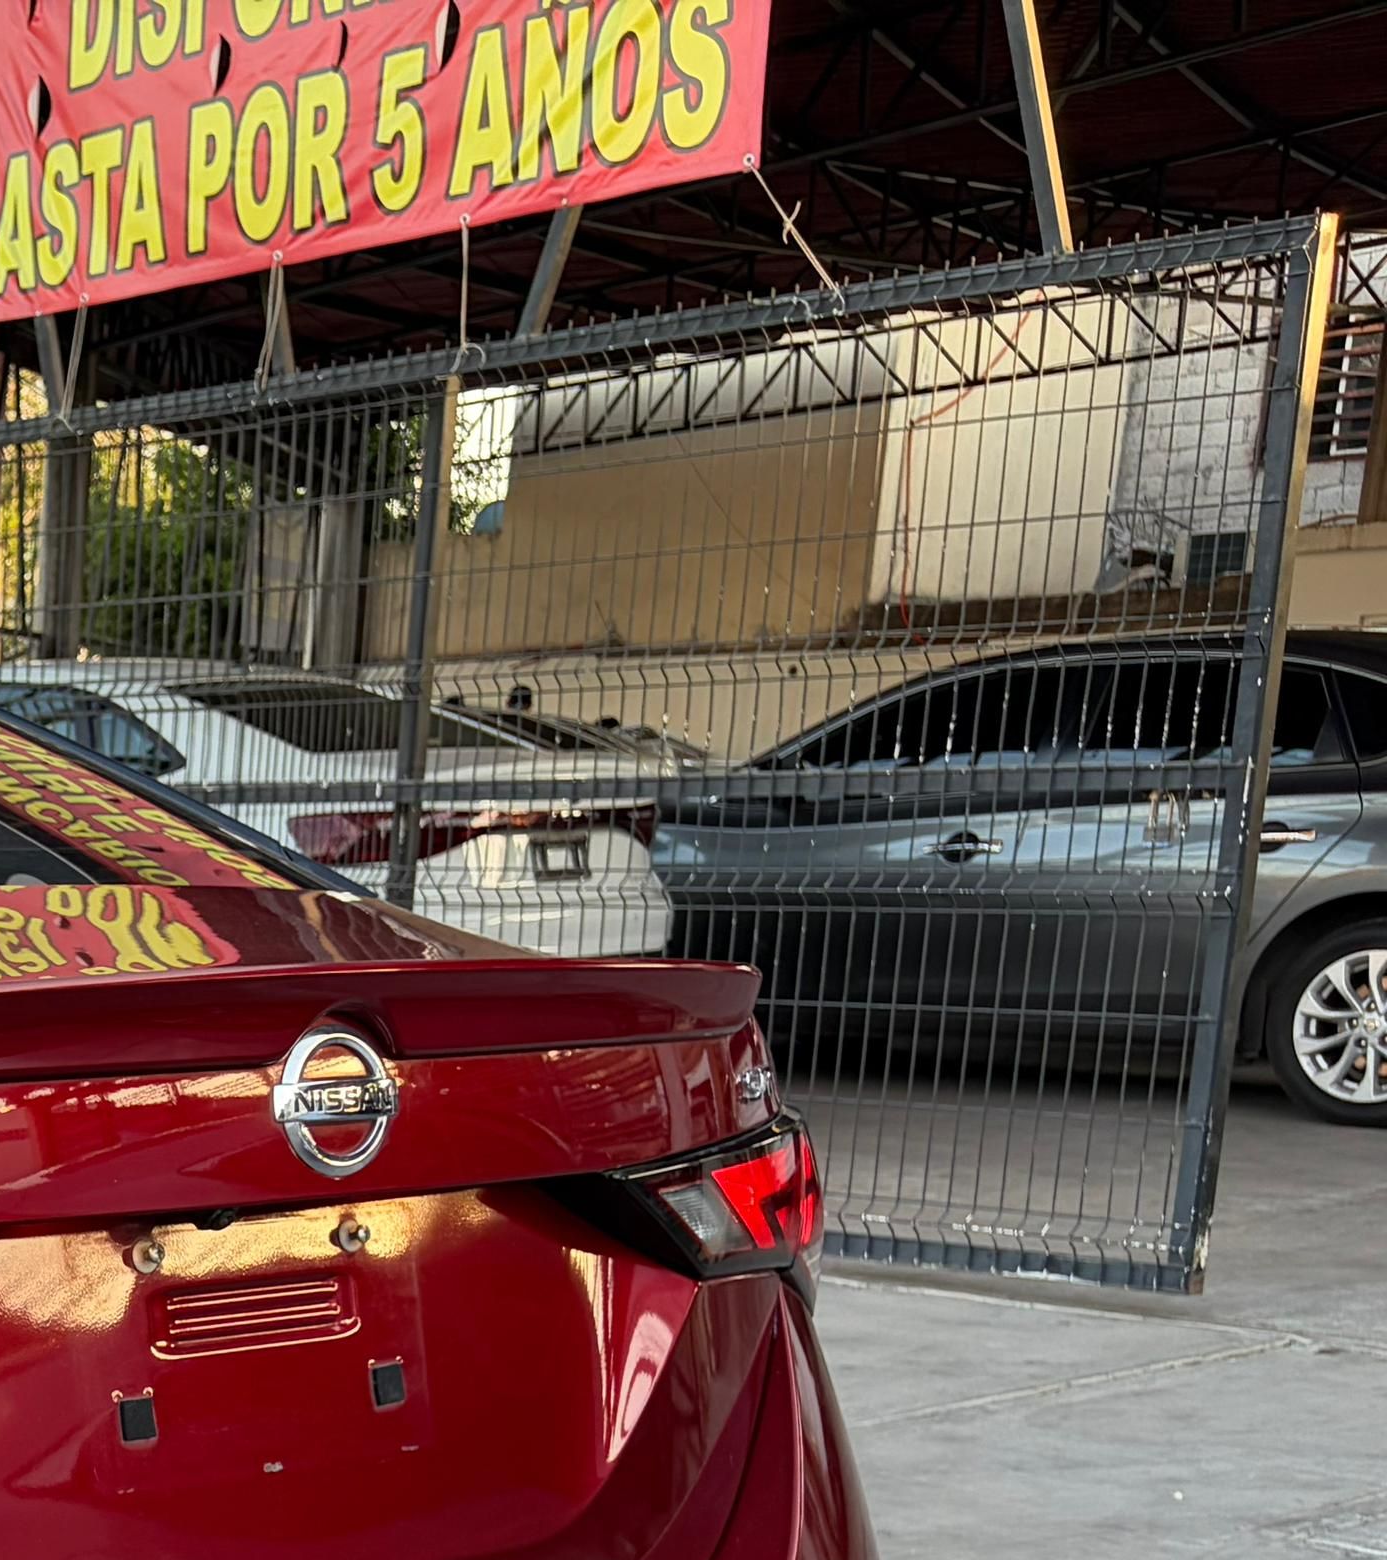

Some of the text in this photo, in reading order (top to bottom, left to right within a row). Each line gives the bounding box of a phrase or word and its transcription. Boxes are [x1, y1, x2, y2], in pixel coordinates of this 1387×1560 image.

[185, 68, 350, 257] POR
[370, 42, 429, 216] 5
[445, 0, 734, 201] AÑOS
[293, 1083, 393, 1114] NISSAN
